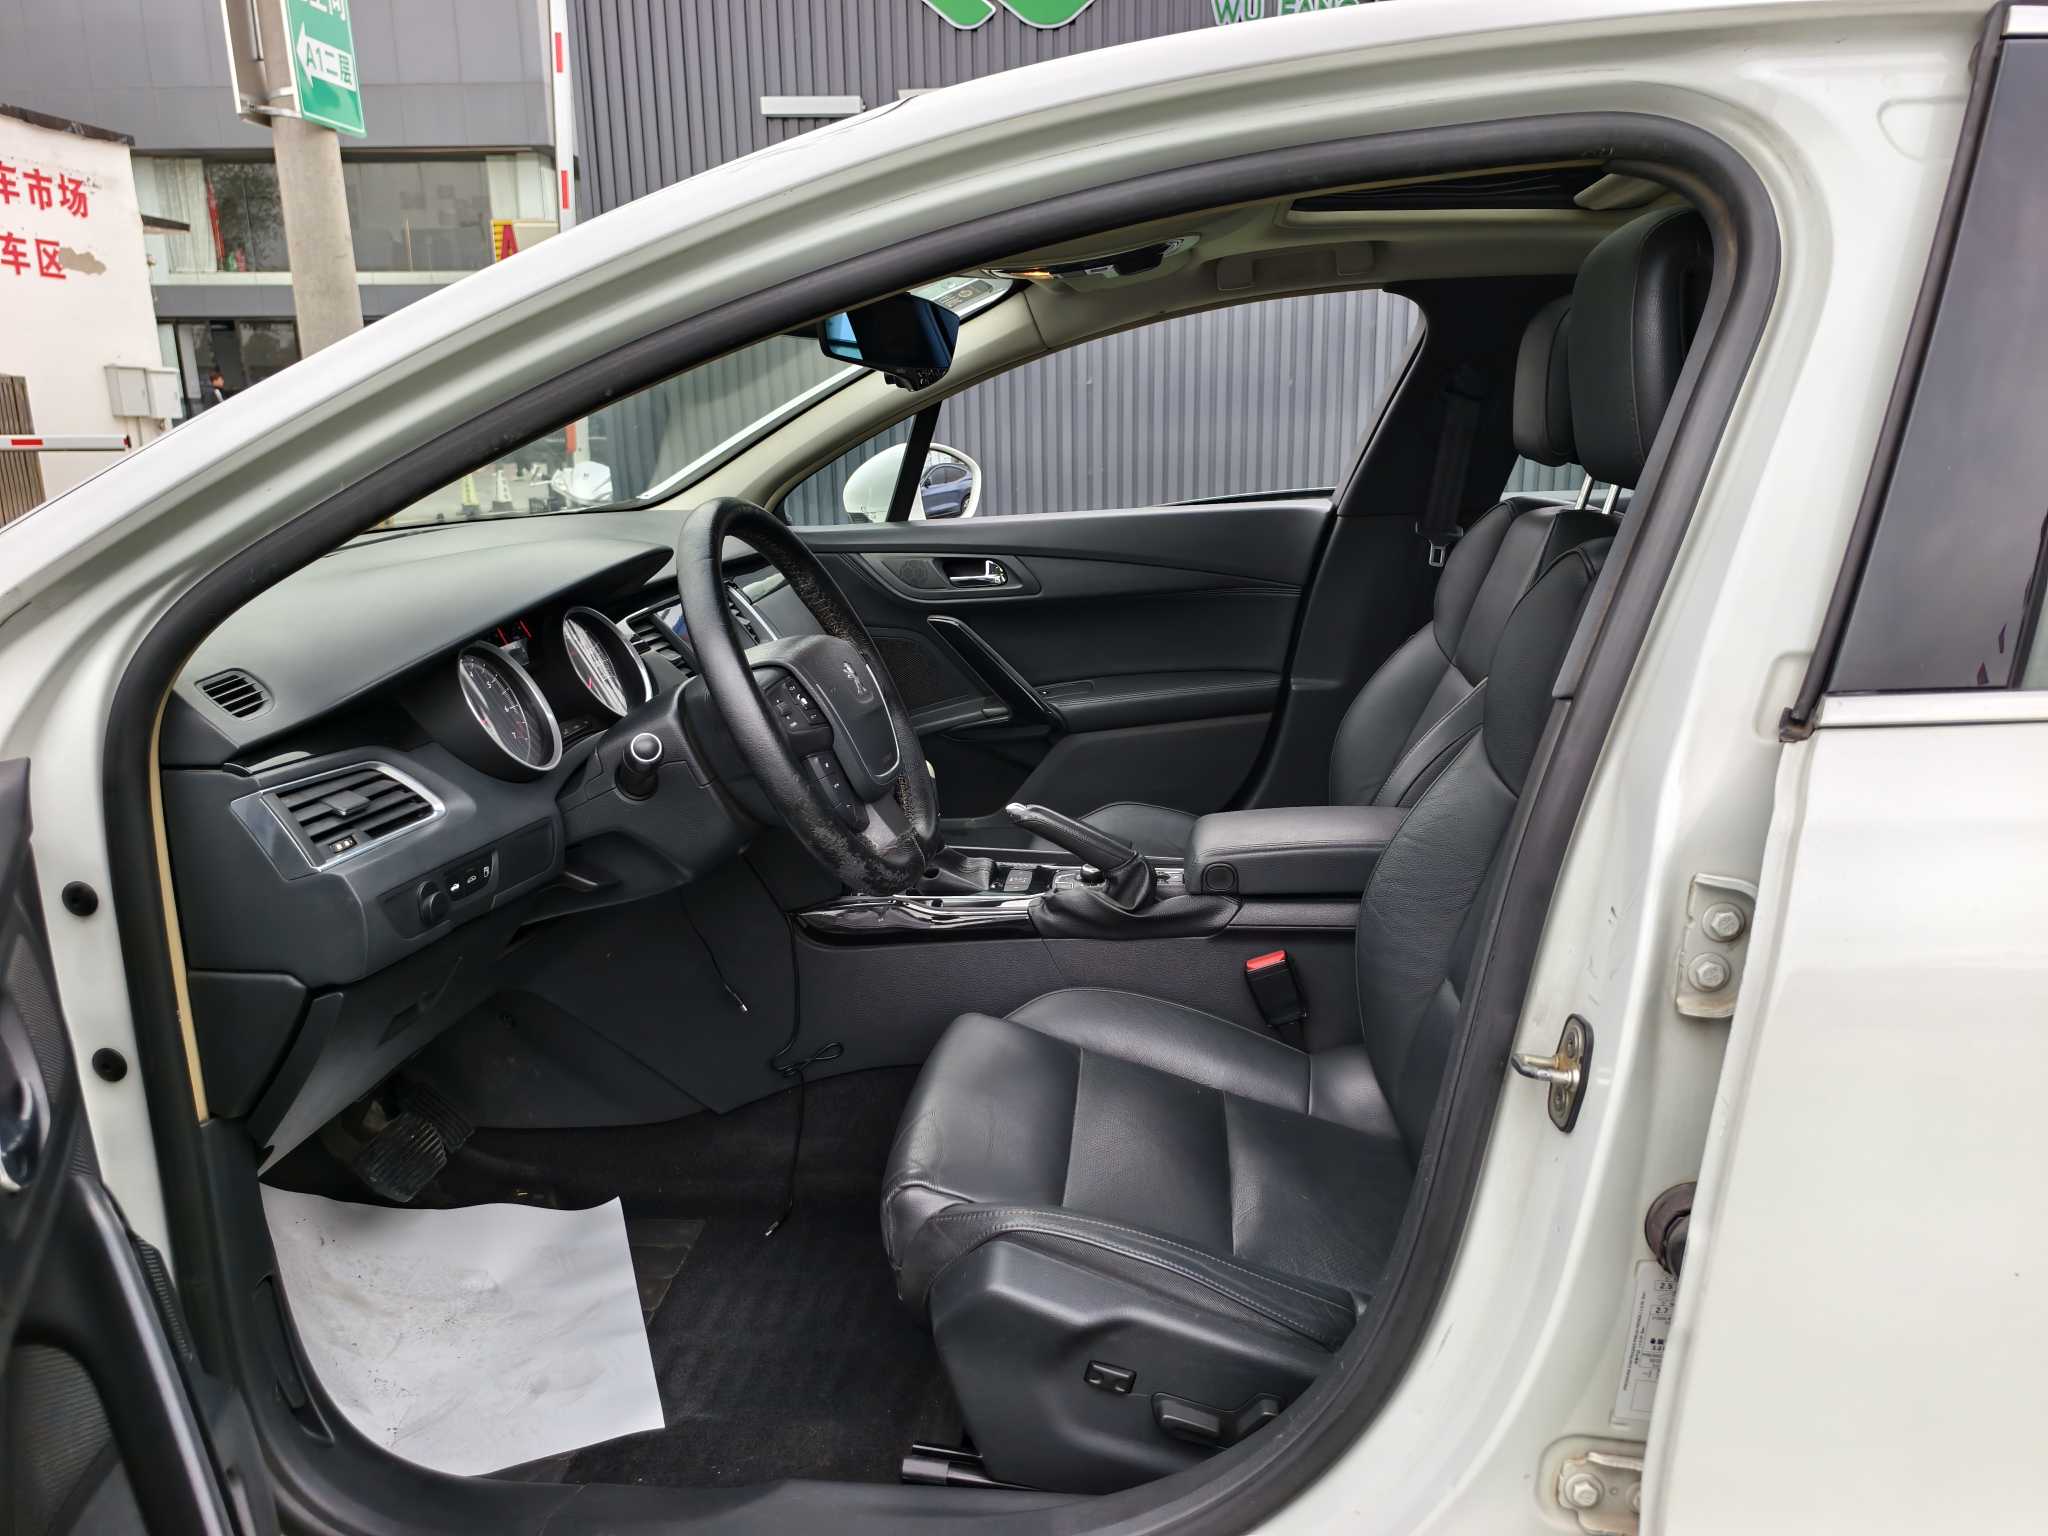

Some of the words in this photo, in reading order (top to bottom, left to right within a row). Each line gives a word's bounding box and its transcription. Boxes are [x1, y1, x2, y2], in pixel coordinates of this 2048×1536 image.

[1212, 0, 1263, 25] WU
[305, 42, 352, 85] A1二层
[0, 232, 66, 279] 车区
